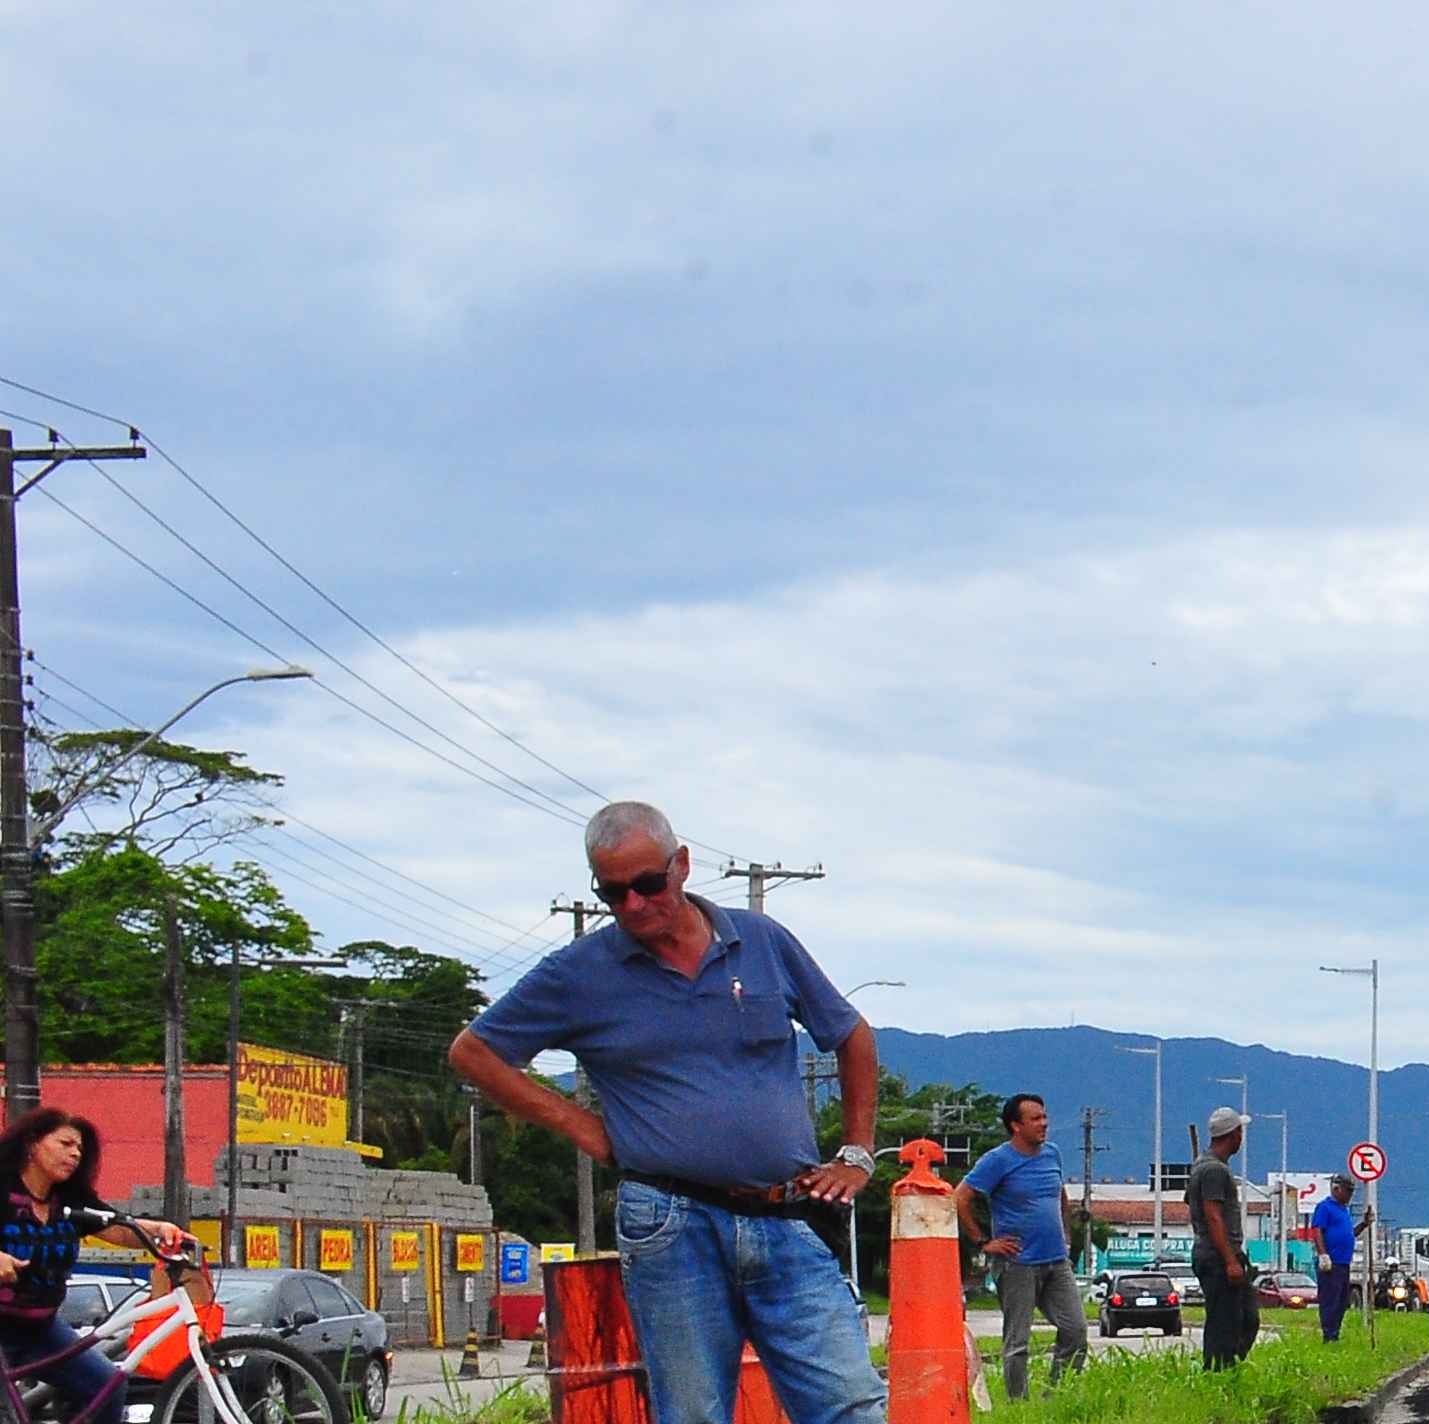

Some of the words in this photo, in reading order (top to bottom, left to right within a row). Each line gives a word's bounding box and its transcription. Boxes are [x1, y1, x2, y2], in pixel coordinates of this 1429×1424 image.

[248, 1233, 278, 1260] AREIA
[323, 1237, 352, 1263] PEDRA
[1142, 1239, 1185, 1250] COPRA
